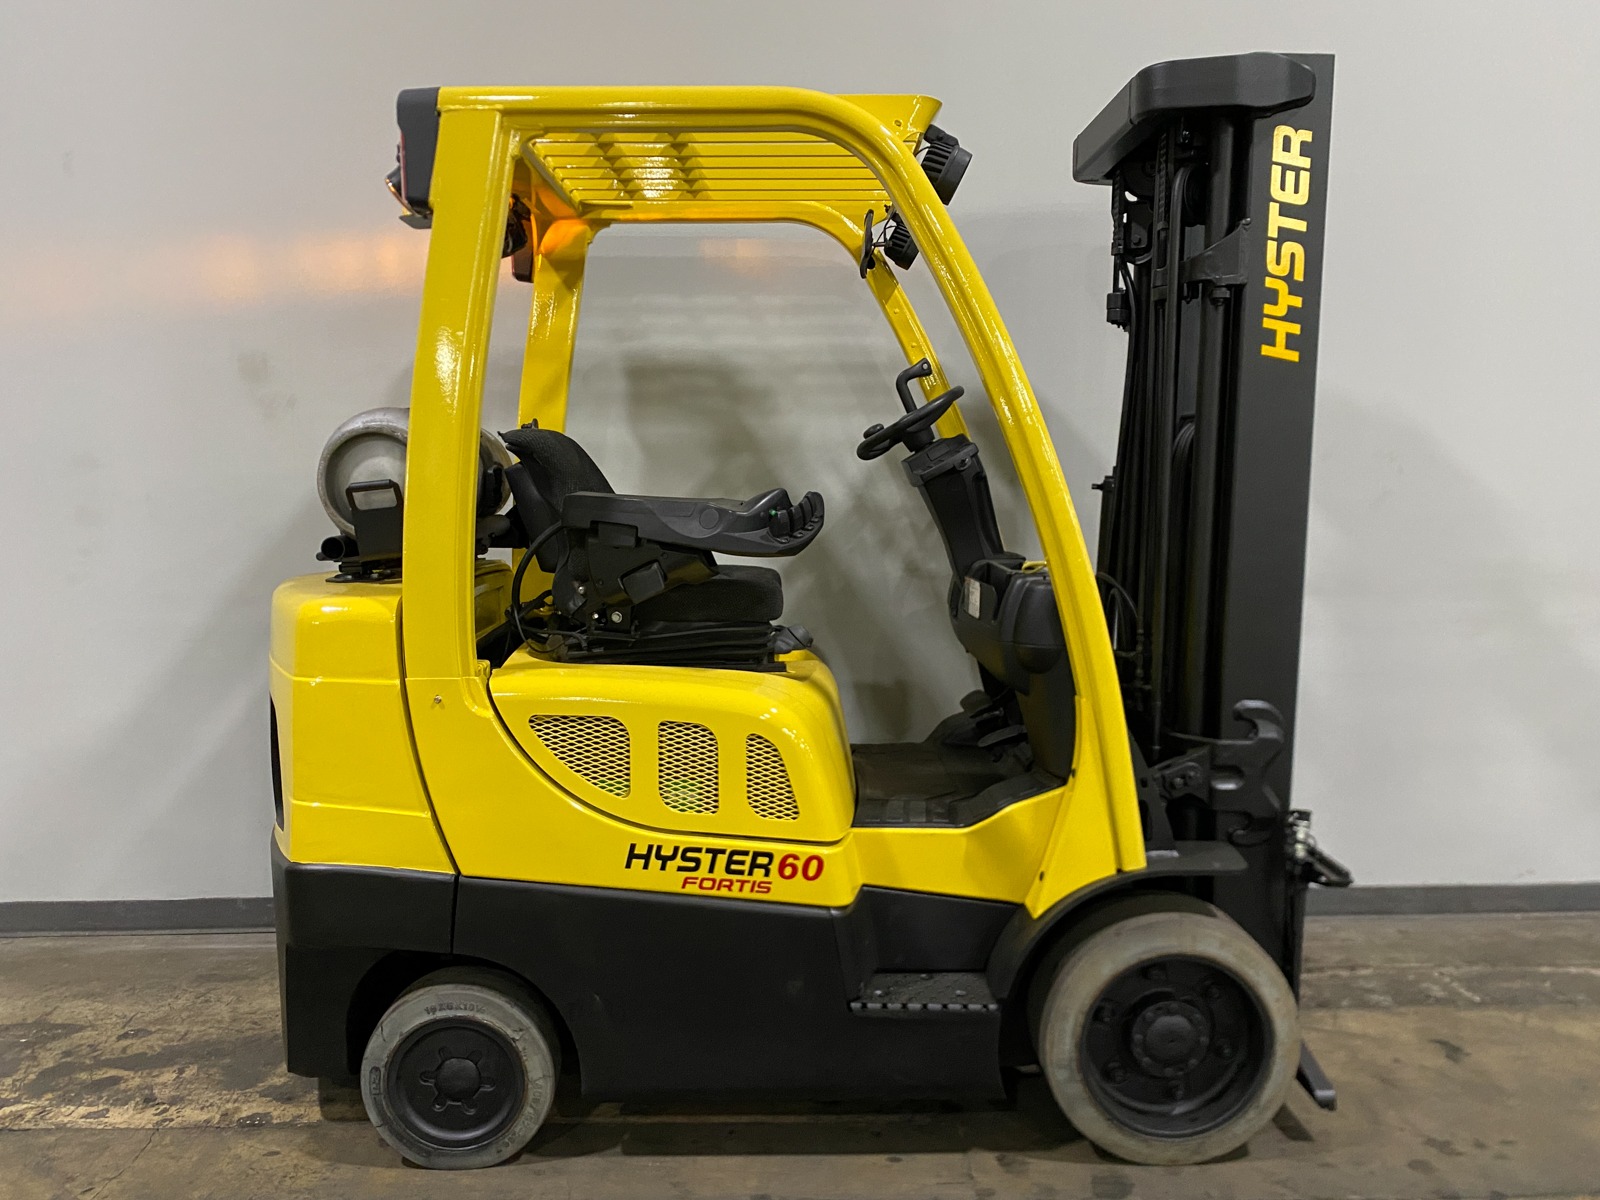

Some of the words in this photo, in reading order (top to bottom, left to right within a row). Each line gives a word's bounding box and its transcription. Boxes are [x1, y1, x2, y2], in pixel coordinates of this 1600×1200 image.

[1261, 124, 1313, 362] HYSTER
[624, 843, 774, 877] HYSTER
[778, 853, 824, 881] 60
[681, 877, 773, 894] FORTIS
